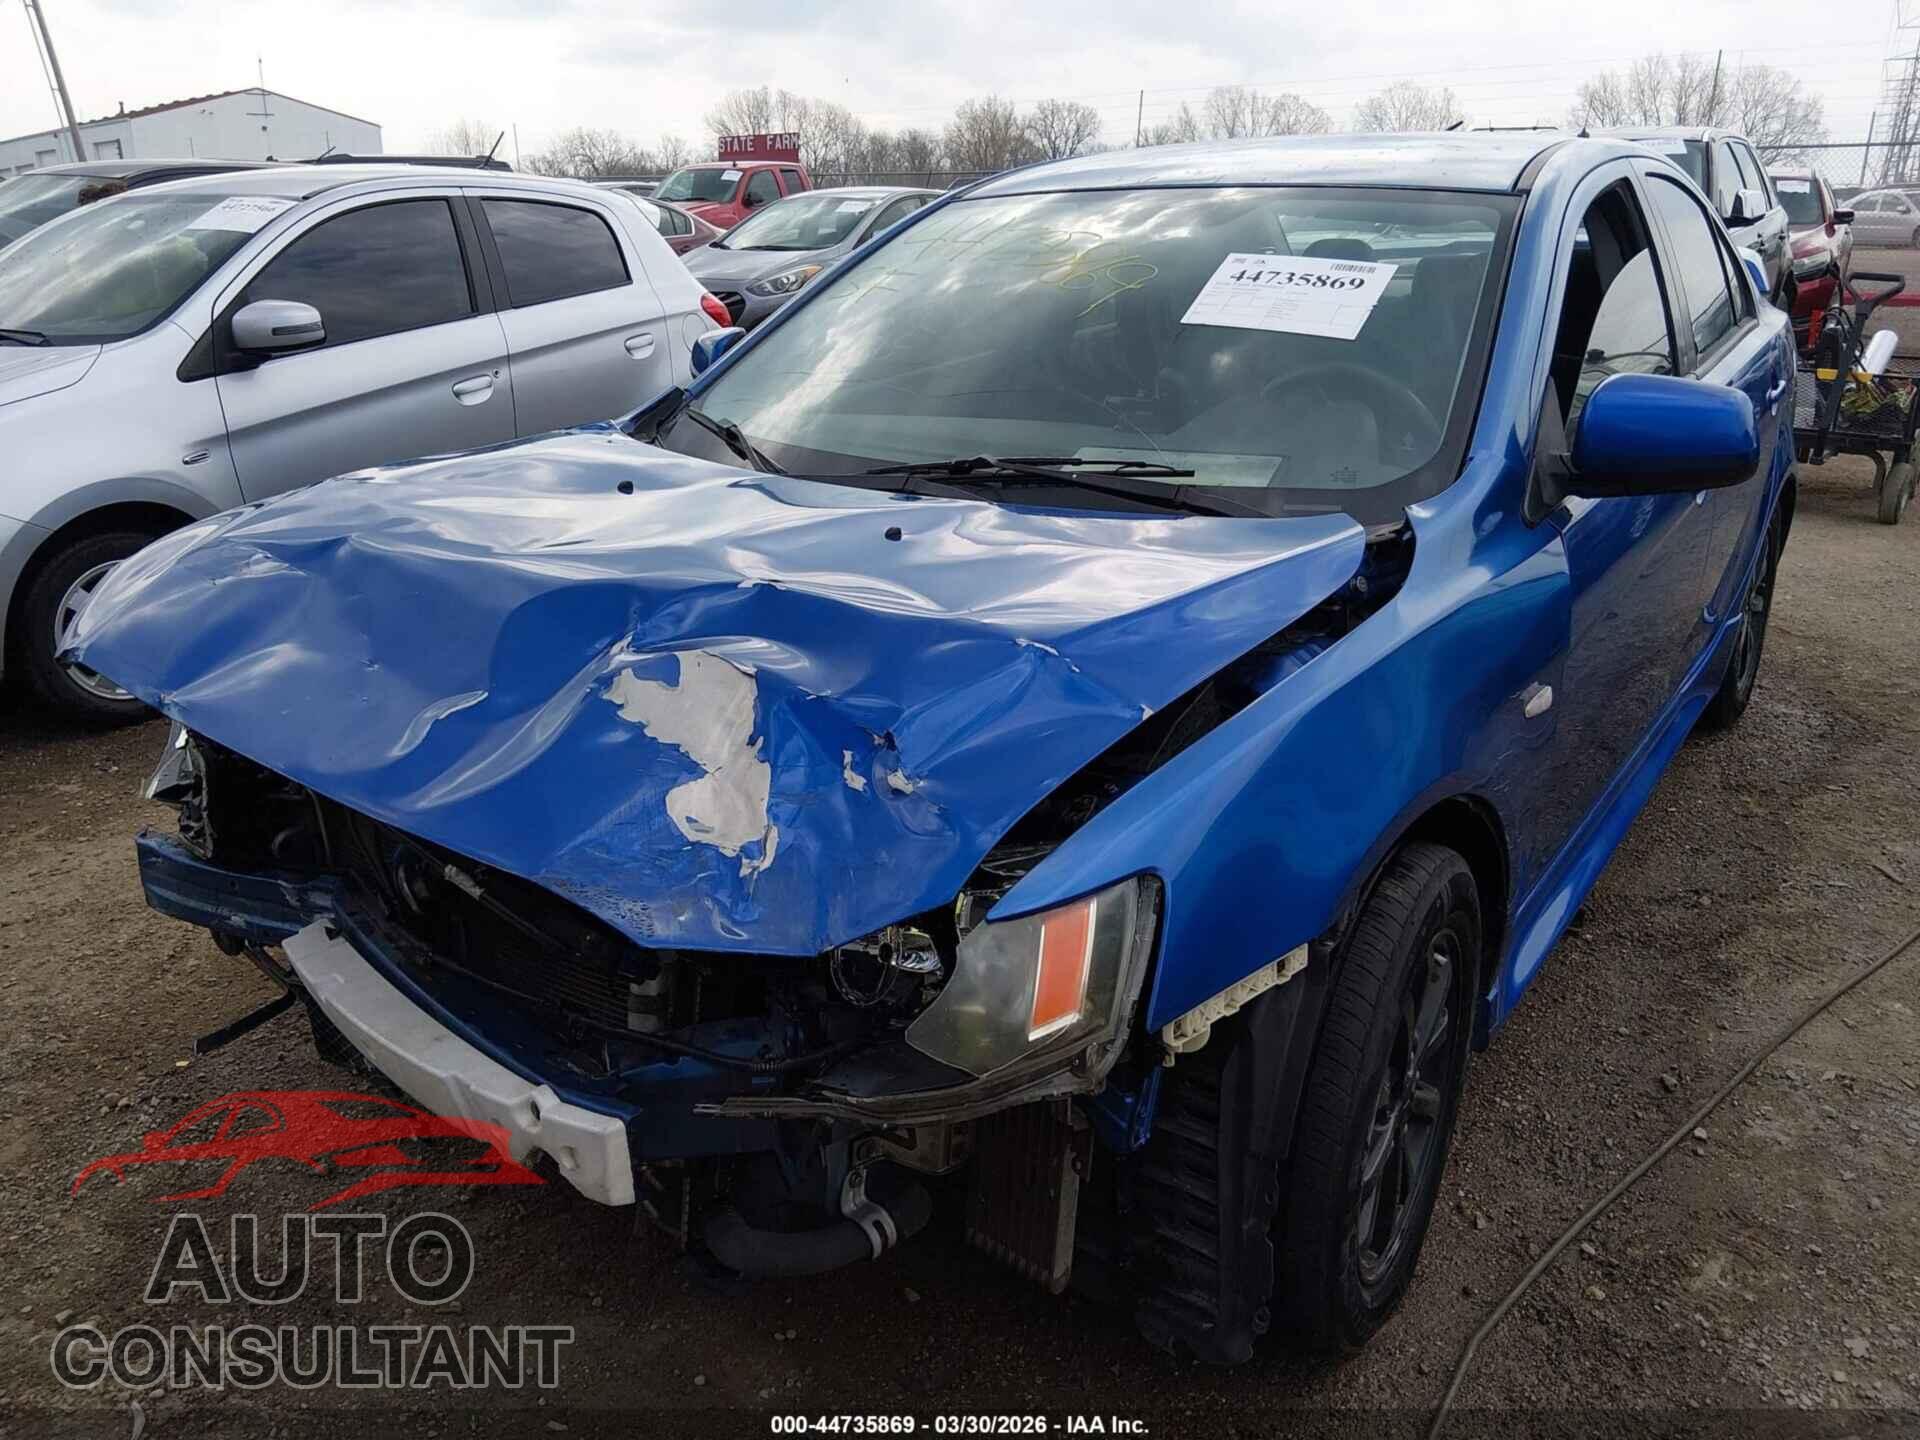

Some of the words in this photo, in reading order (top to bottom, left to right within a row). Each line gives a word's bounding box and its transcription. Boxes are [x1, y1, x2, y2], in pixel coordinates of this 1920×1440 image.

[719, 135, 755, 153] STATE
[766, 133, 799, 150] FARM
[1229, 268, 1367, 291] 44735869
